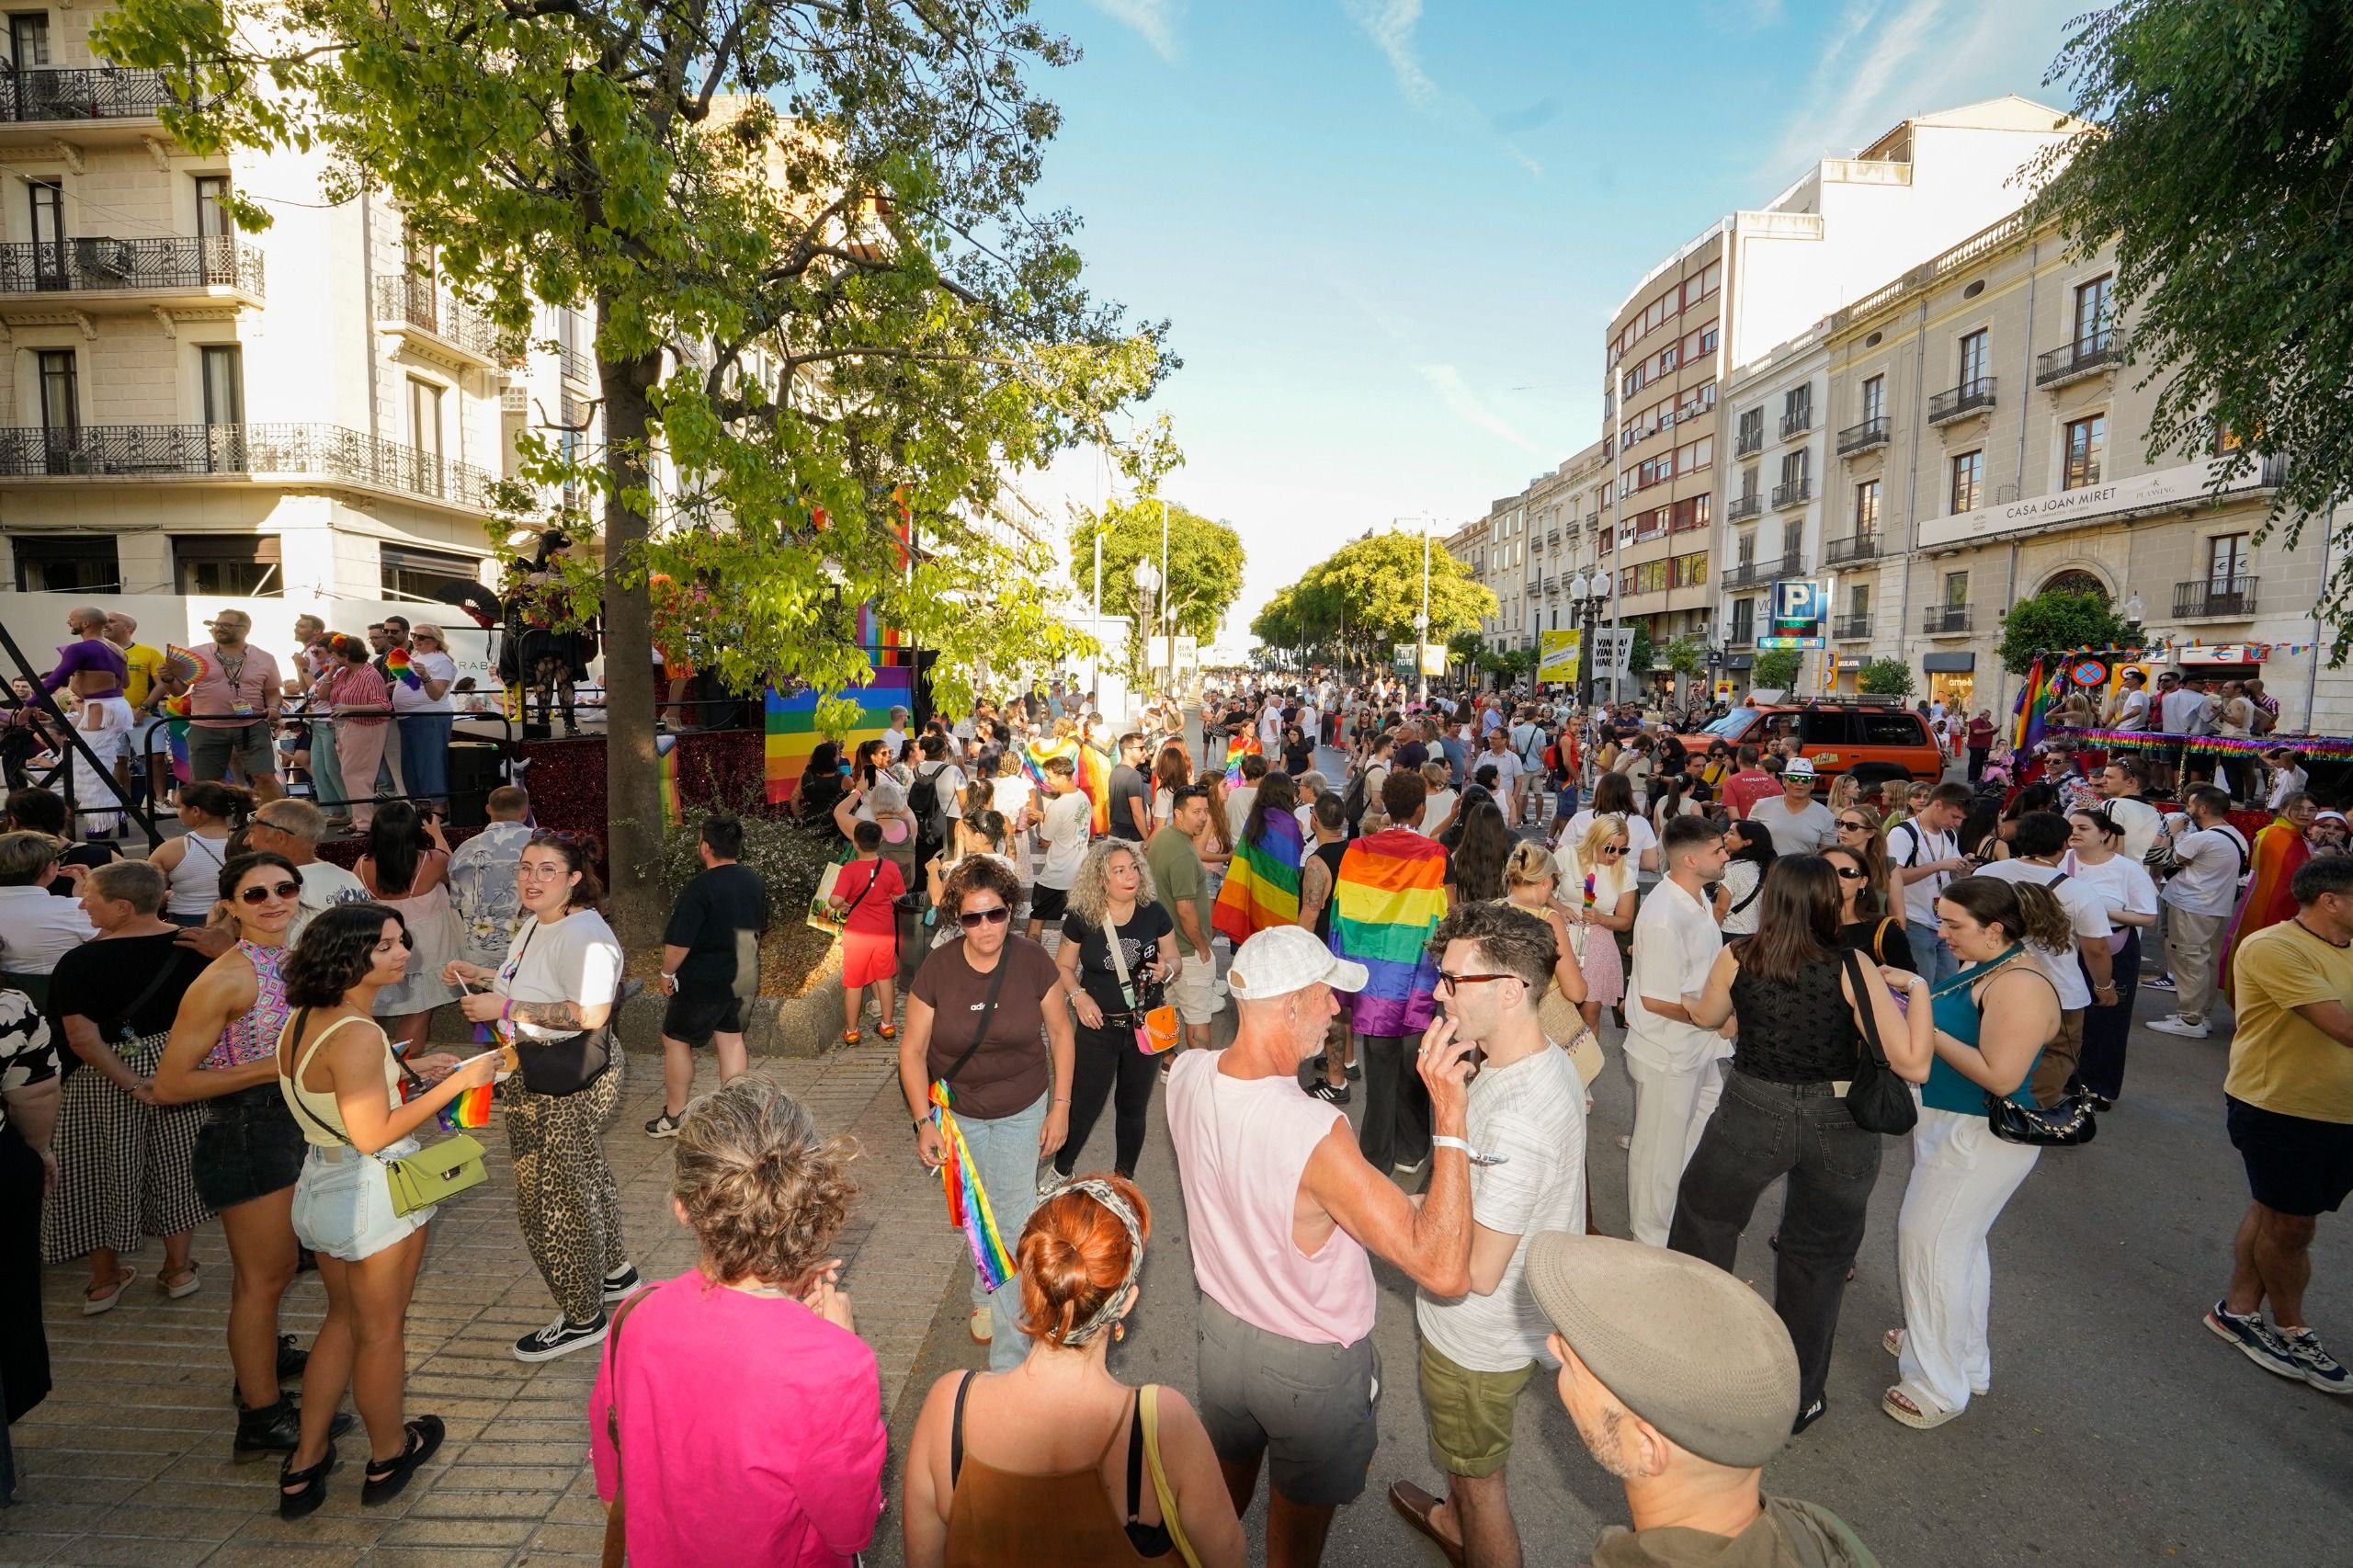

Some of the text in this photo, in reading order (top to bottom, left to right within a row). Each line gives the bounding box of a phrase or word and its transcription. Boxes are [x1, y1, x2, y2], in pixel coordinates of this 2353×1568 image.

[2006, 487, 2117, 518] CASA JOAN MIRET
[1784, 585, 1810, 616] P
[1597, 638, 1628, 647] VINA!
[1596, 647, 1626, 657] VINA!
[1397, 658, 1414, 666] POTS
